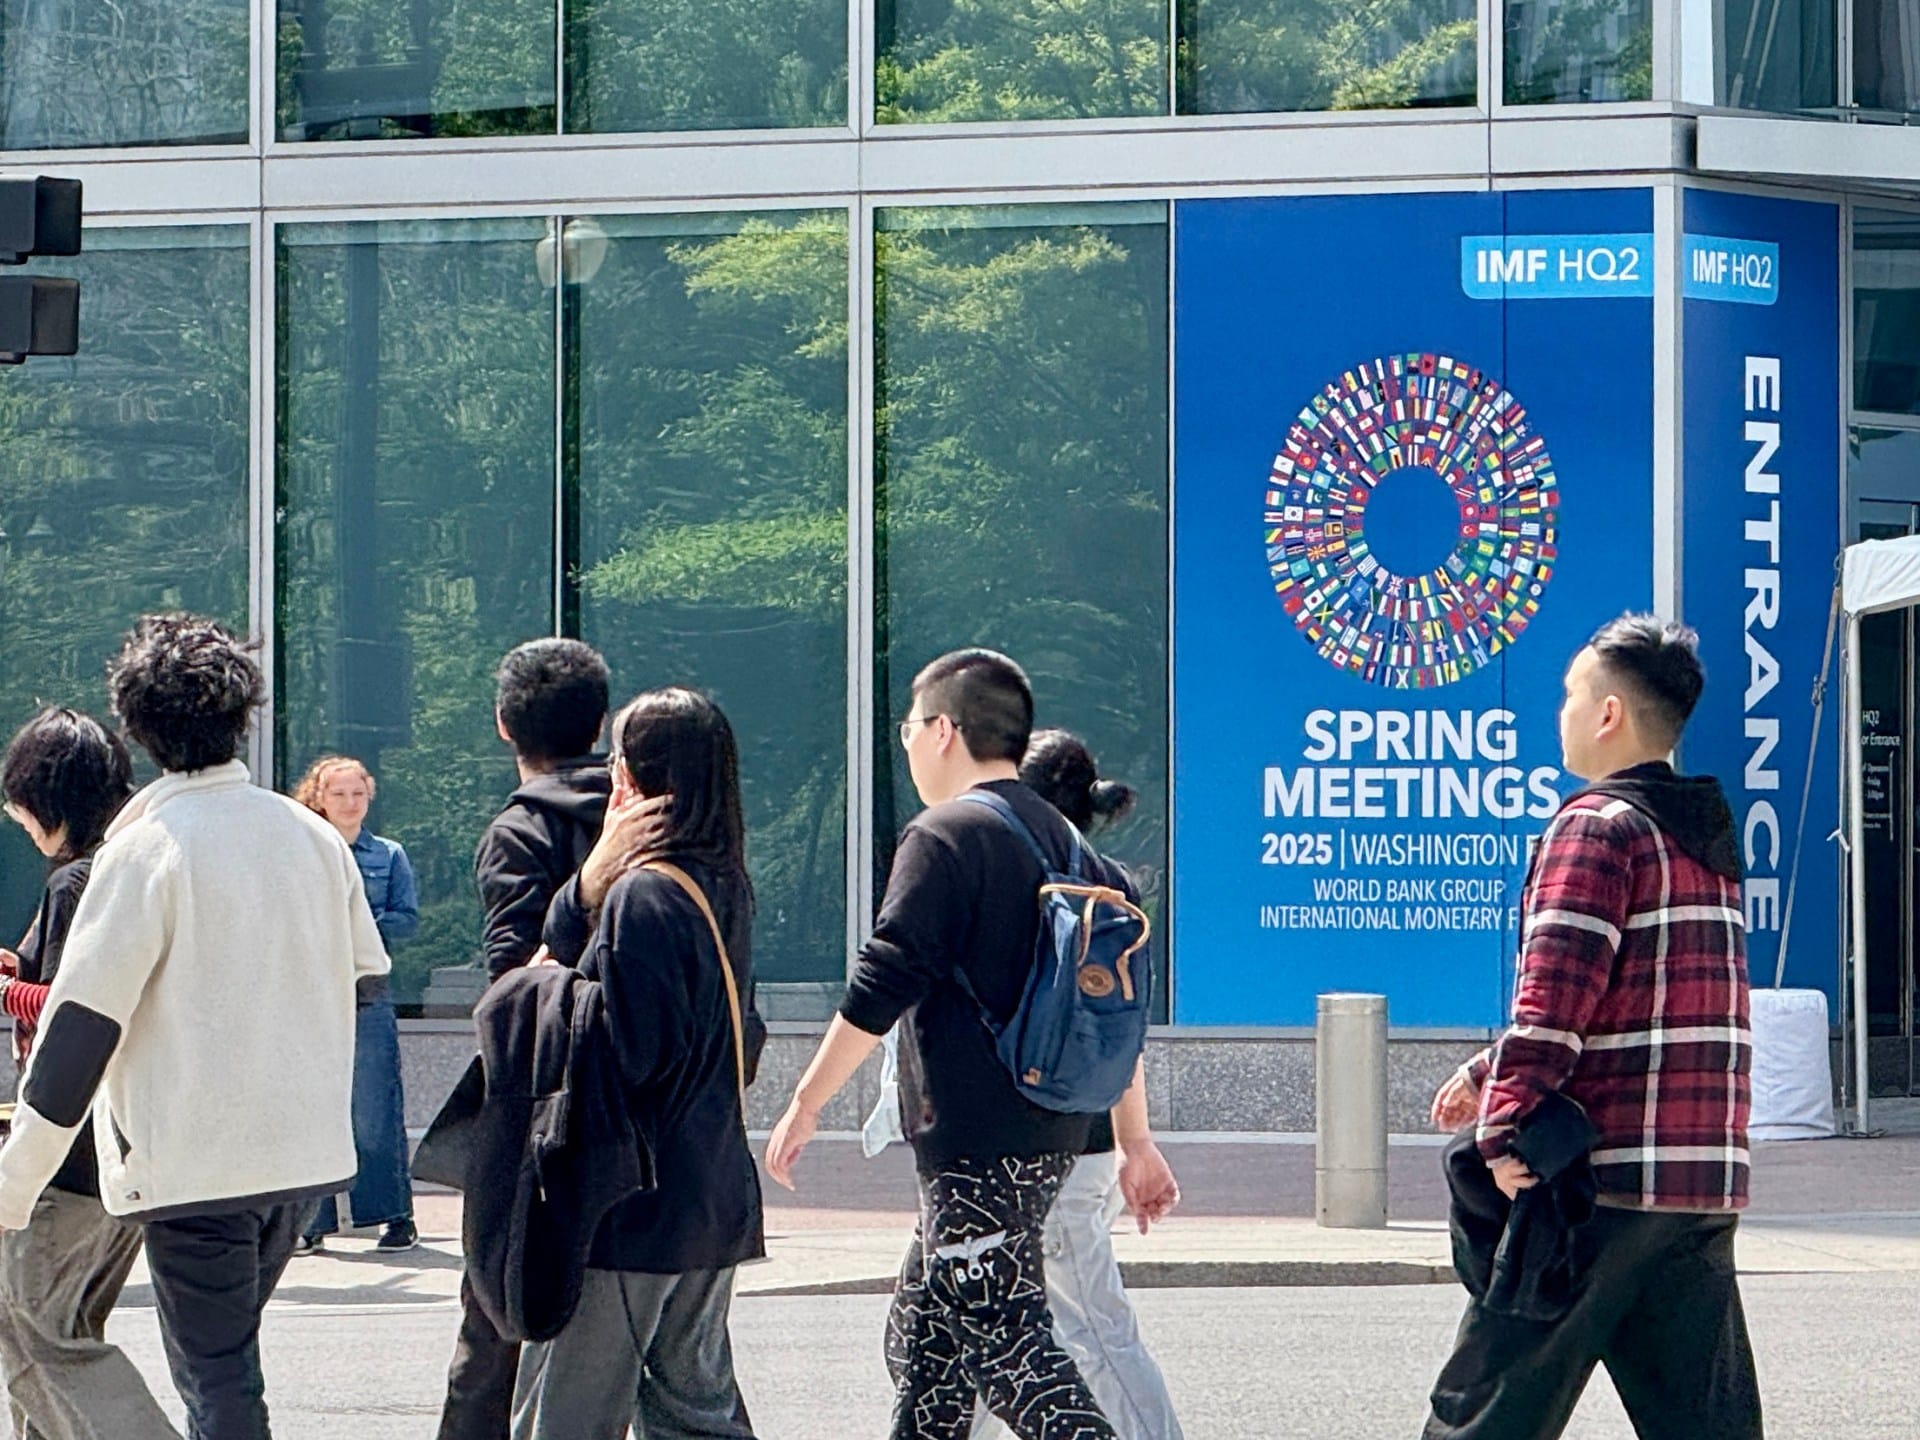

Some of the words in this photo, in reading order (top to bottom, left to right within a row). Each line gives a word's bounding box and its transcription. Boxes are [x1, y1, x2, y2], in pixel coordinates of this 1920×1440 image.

[1477, 249, 1547, 282] IMF
[1559, 247, 1639, 282] HQ2
[1692, 249, 1728, 284] IMF
[1732, 253, 1772, 290] HQ2
[1743, 355, 1781, 935] ENTRANCE
[1303, 708, 1518, 762] SPRING
[1263, 766, 1562, 819] MEETINGS
[1261, 832, 1333, 866] 2025
[1351, 833, 1518, 866] WASHINGTON
[1313, 878, 1381, 902] WORLD
[1386, 879, 1436, 902] BANK
[1440, 879, 1505, 903] GROUP
[1260, 905, 1402, 930] INTERNATIONAL
[1404, 906, 1503, 930] MONETARY
[955, 1260, 995, 1284] BOY
